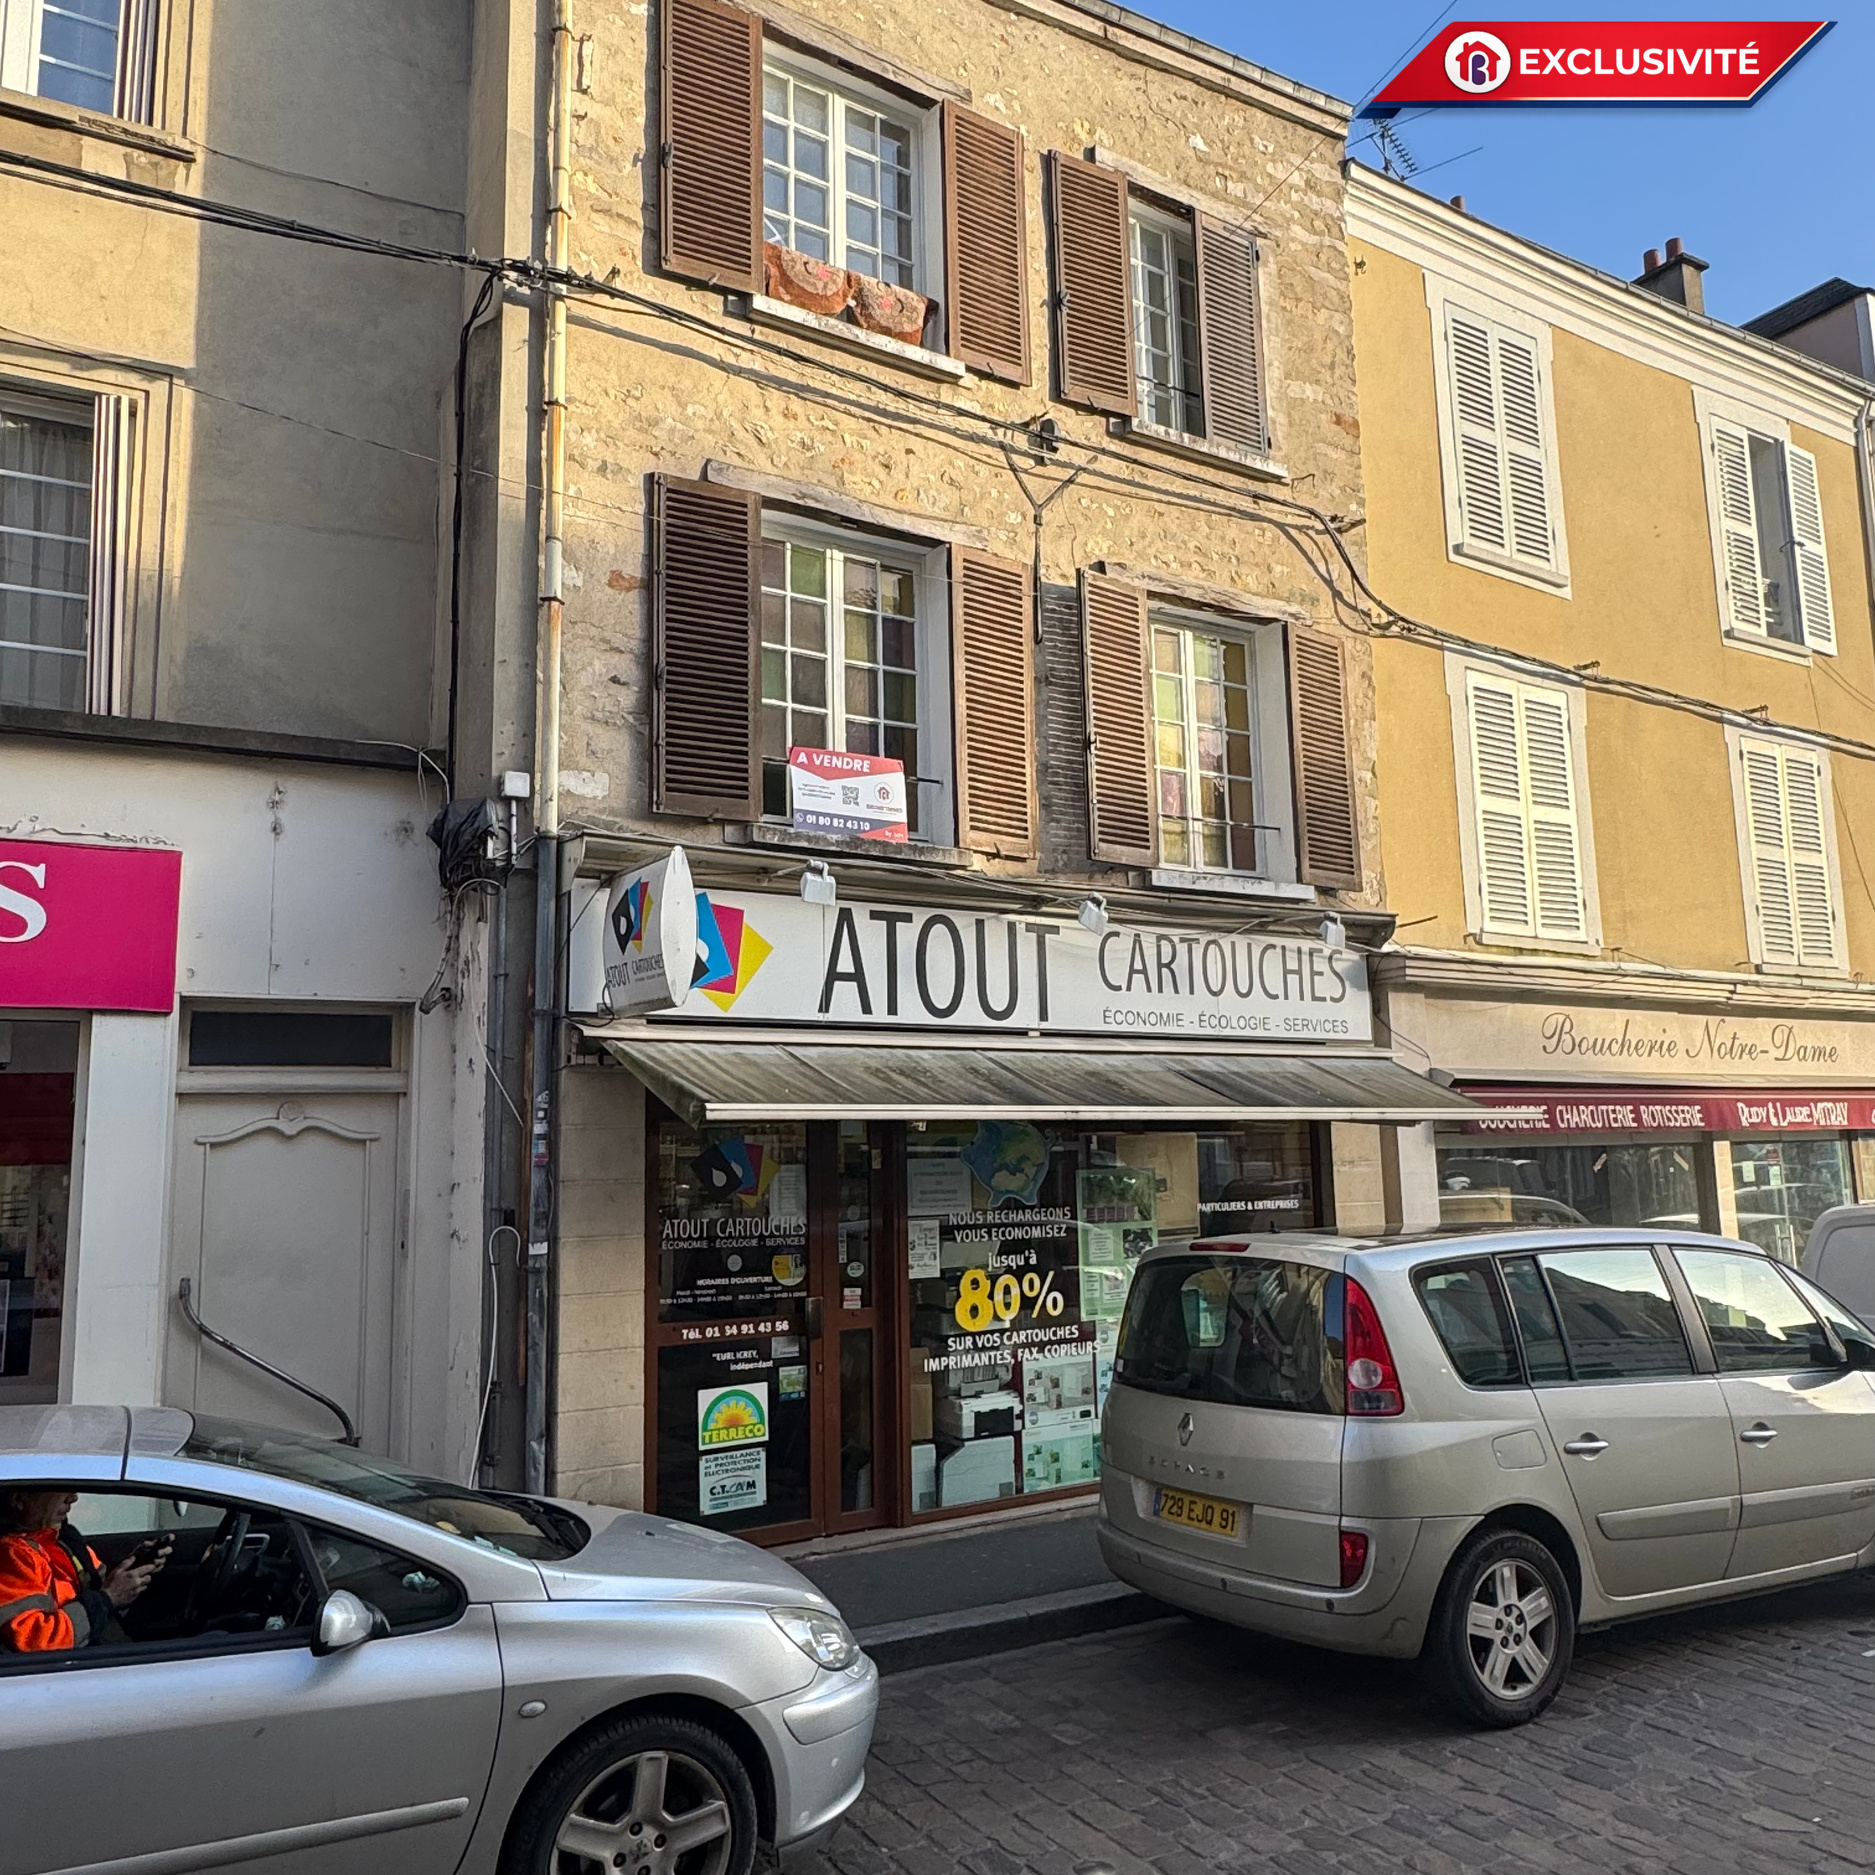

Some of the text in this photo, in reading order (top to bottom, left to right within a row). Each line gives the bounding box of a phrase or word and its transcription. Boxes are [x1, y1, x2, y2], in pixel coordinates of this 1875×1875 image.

[797, 752, 871, 773] A VENDRE
[806, 814, 870, 831] 01 80 82 43 10
[606, 961, 631, 989] ATOUT
[817, 906, 1348, 1024] ATOUT CARTOUCHES
[1102, 1006, 1185, 1028] ÉCONOMIE
[1199, 1010, 1271, 1031] ÉCOLOGIE
[1283, 1017, 1349, 1034] SERVICES
[1541, 1011, 1840, 1063] Boucherie Notre-Dame
[1556, 1104, 1638, 1128] CHARCUTERIE
[1641, 1104, 1705, 1128] ROTISSERIE
[950, 1206, 1071, 1226] NOUS RECHARGEONS
[1197, 1200, 1246, 1213] PARTICULIERS
[1254, 1199, 1300, 1210] ENTREPRISES
[662, 1215, 807, 1239] ATOUT CARTOUCHES
[954, 1223, 1067, 1243] VOUS ECONOMISEZ
[662, 1239, 708, 1250] ÉCONOMIE
[715, 1237, 759, 1248] ÉCOLOGIE
[765, 1236, 806, 1247] SERVICES
[987, 1249, 1037, 1272] jusqu'à
[955, 1268, 1065, 1332] 80%
[705, 1326, 721, 1338] 01
[740, 1323, 755, 1335] 91
[758, 1322, 772, 1333] 43
[775, 1320, 790, 1332] 56
[947, 1325, 1079, 1352] SUR VOS CARTOUCHES
[924, 1340, 1101, 1373] IMPRIMANTES, FAX, COPIEURS
[702, 1423, 766, 1444] TERRECO
[704, 1449, 761, 1464] SURVEILLANCE
[715, 1457, 761, 1469] PROTECTION
[1160, 1493, 1236, 1532] 729 EJQ 91
